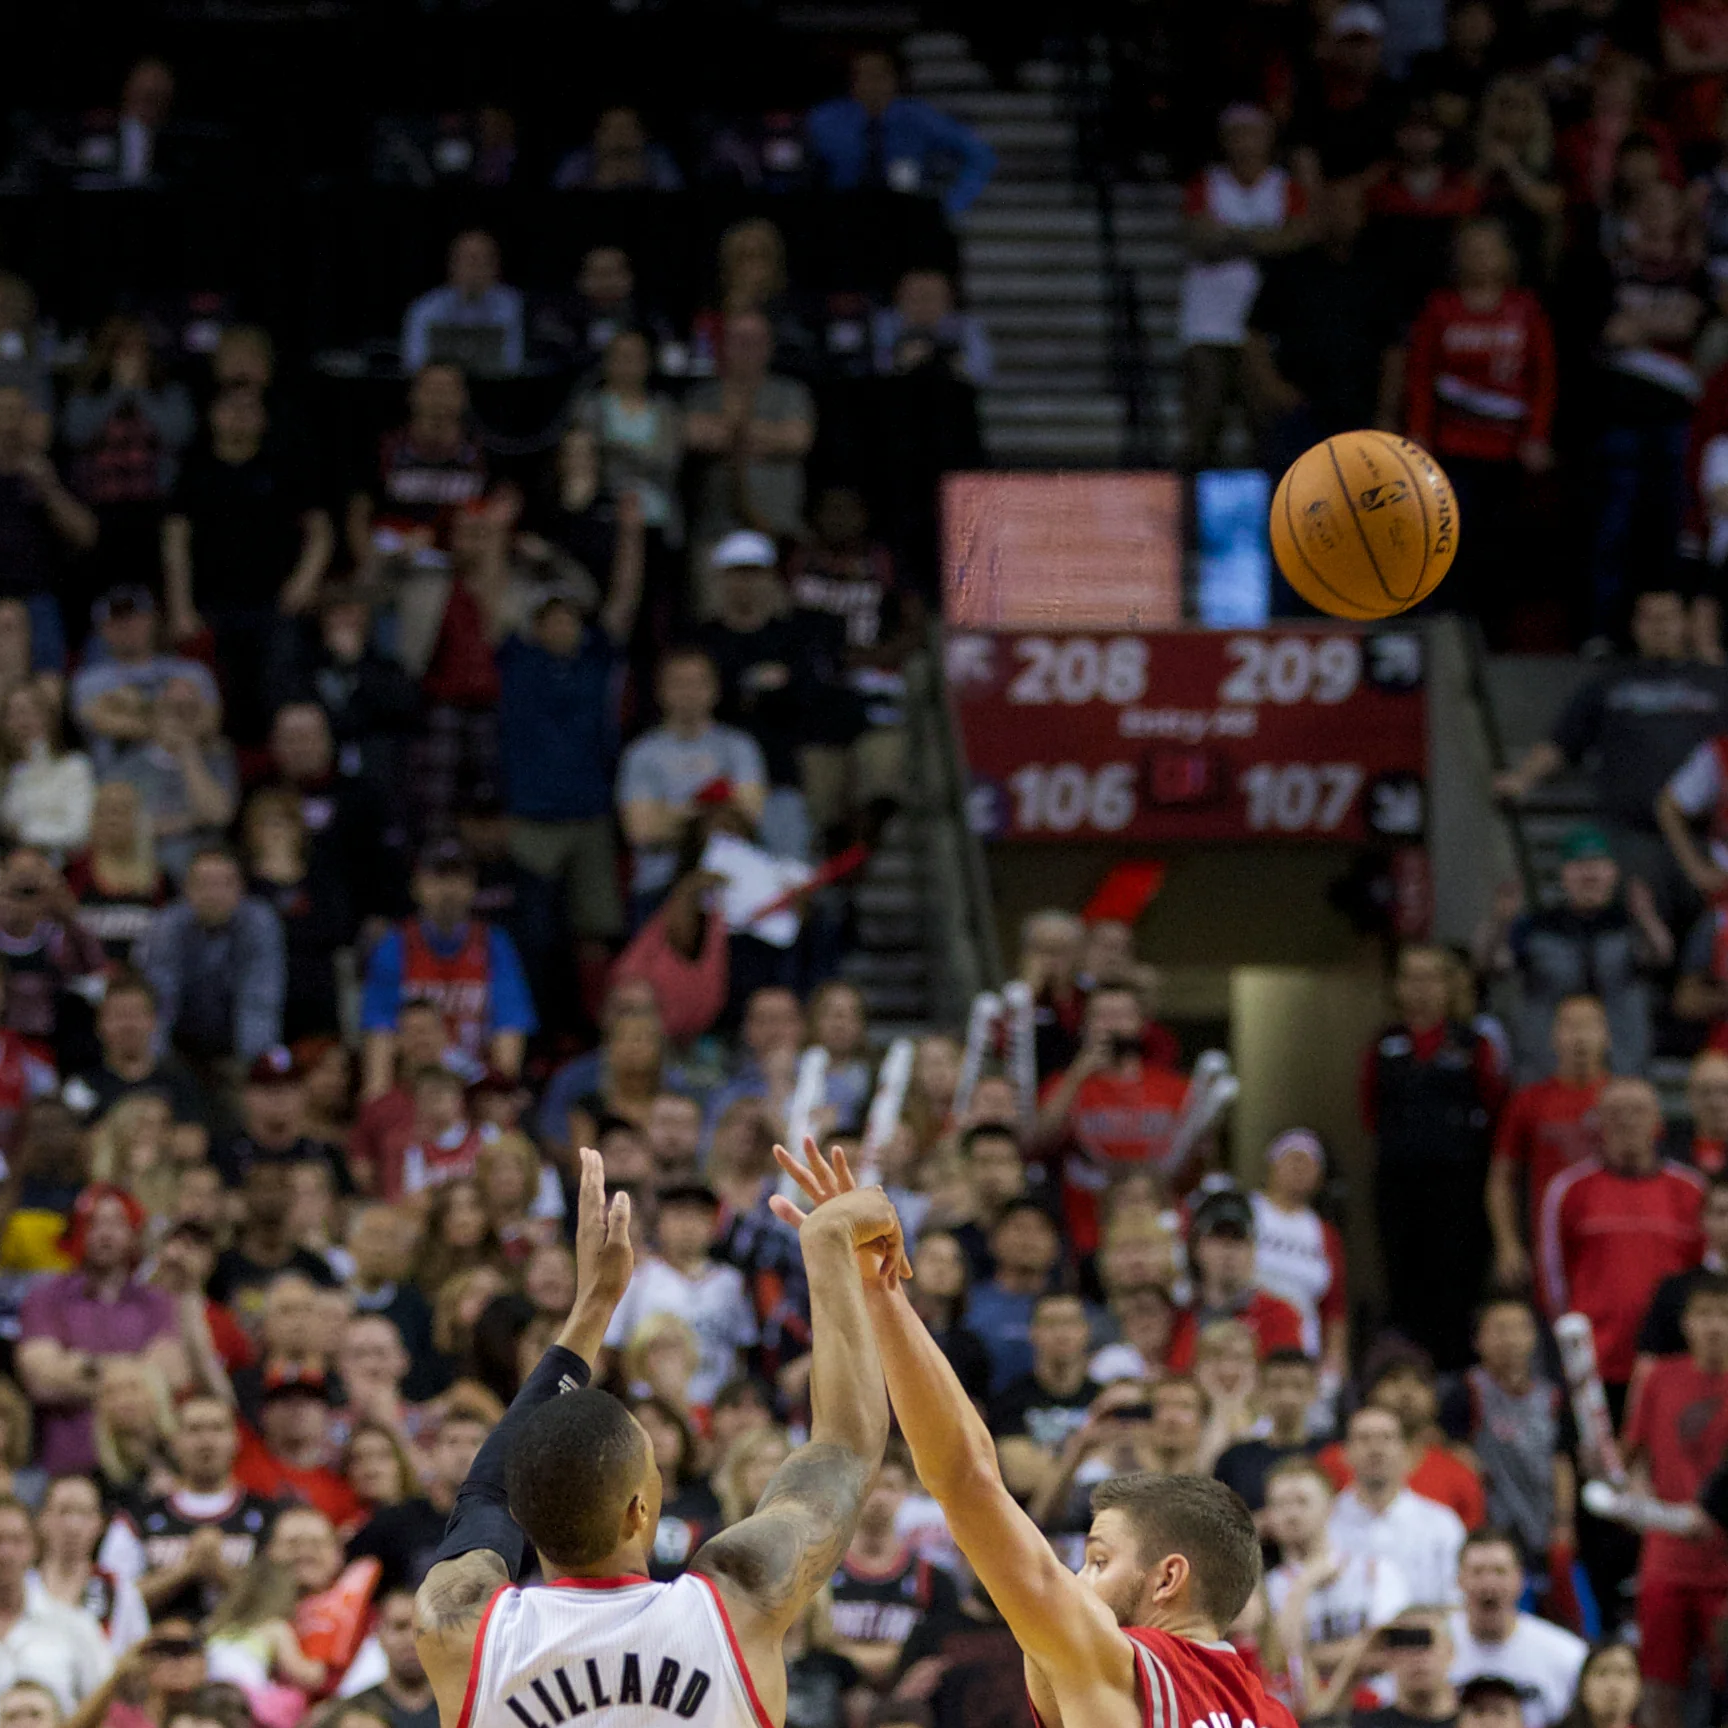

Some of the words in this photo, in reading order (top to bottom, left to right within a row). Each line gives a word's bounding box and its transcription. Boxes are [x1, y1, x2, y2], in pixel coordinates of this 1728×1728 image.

[1006, 635, 1151, 705] 208
[1217, 635, 1362, 705] 209
[1008, 761, 1138, 832] 106
[1237, 761, 1367, 832] 107
